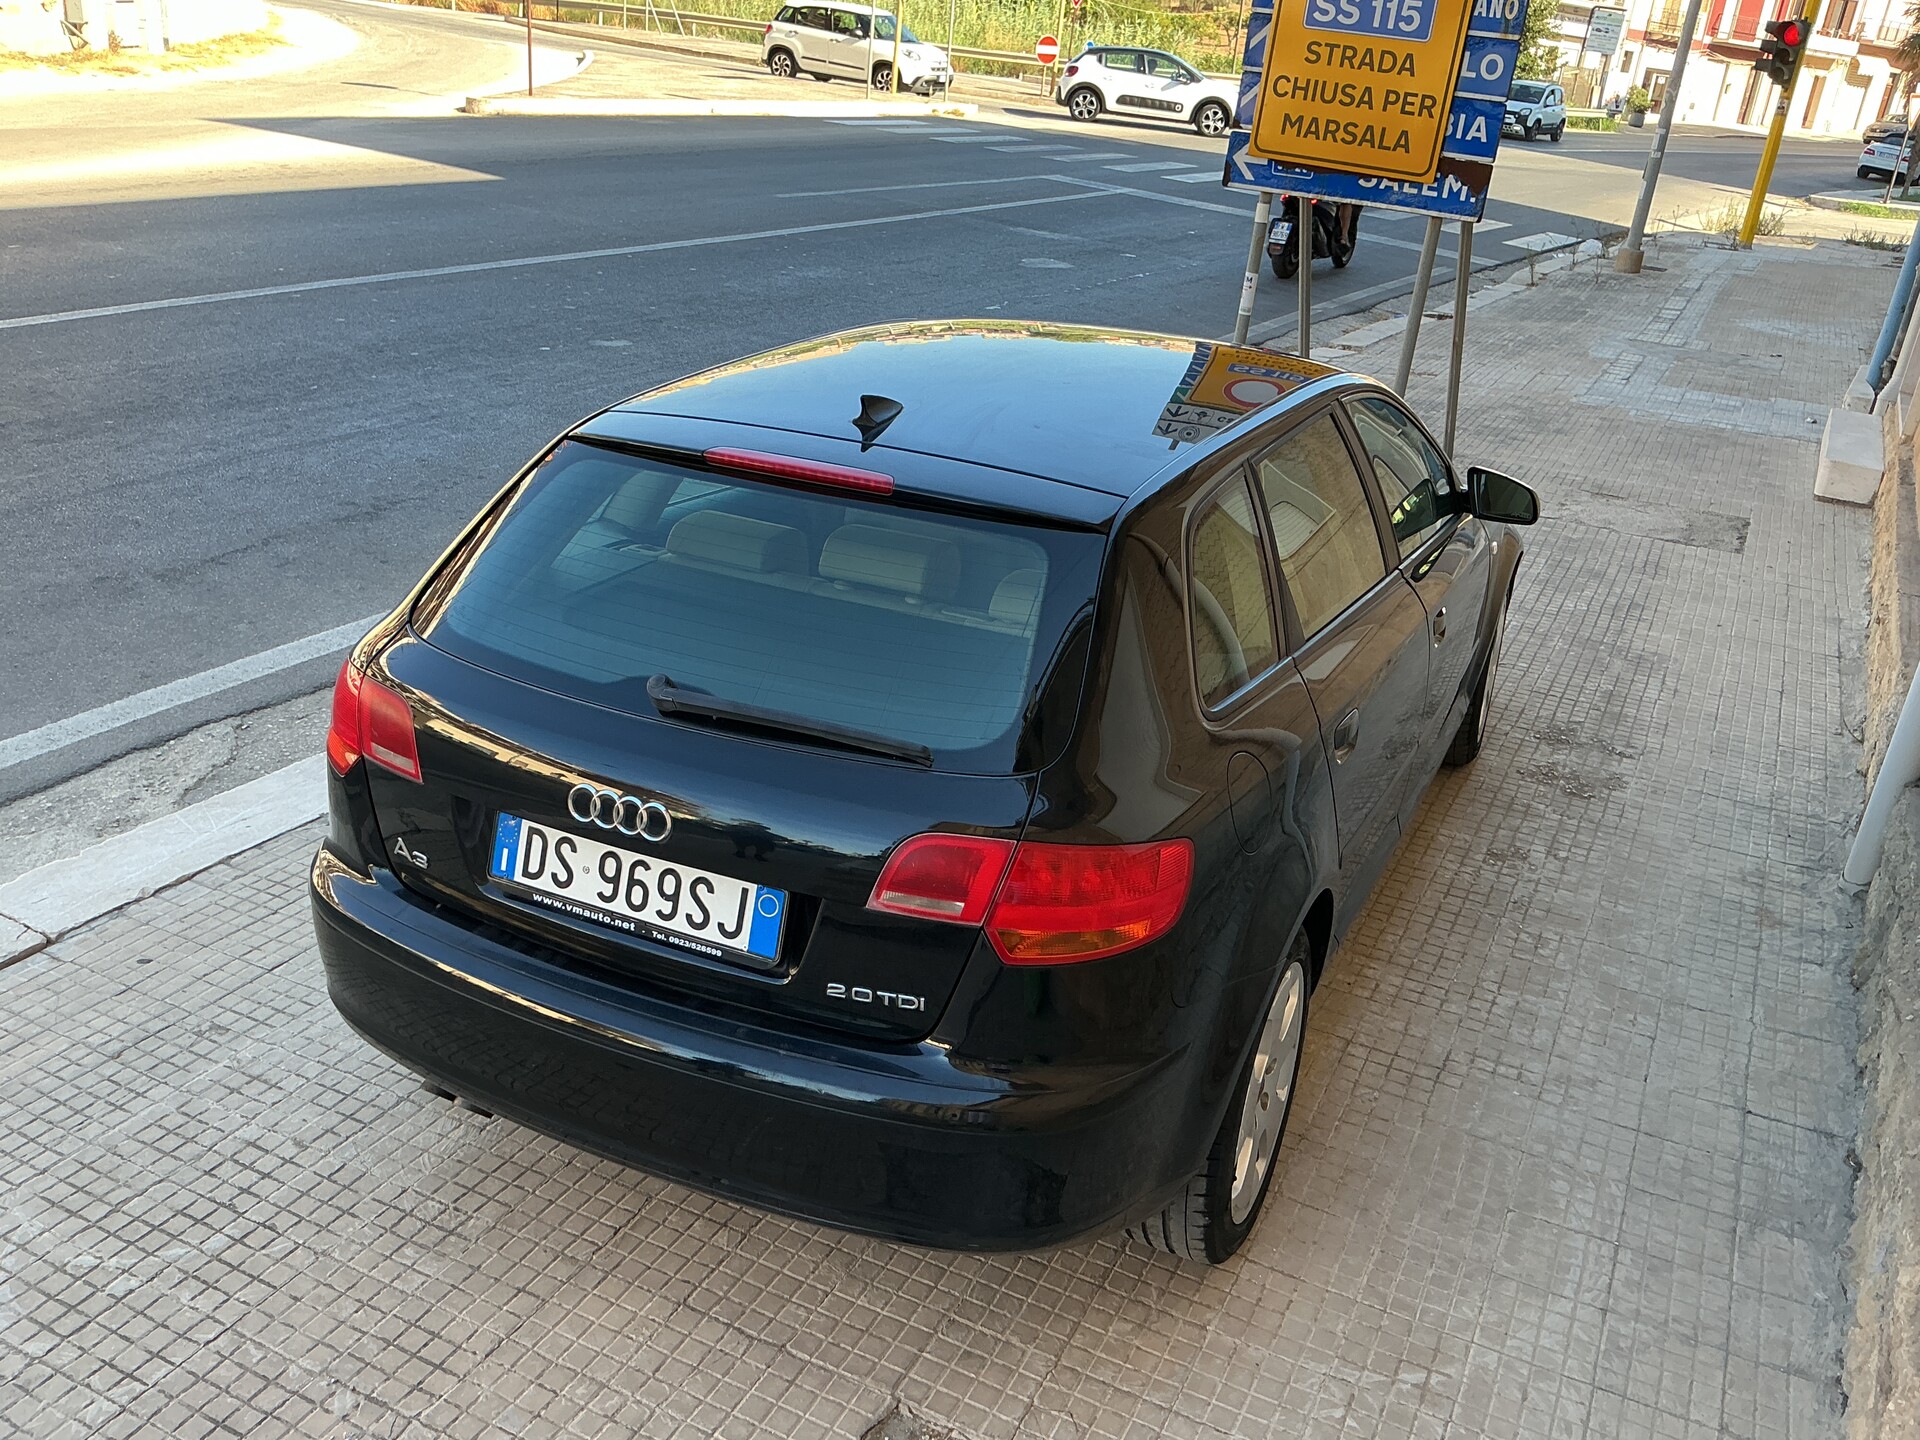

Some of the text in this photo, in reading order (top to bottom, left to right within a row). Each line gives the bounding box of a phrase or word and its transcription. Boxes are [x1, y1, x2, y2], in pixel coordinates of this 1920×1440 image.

[1313, 0, 1421, 31] SS 115
[1304, 41, 1415, 77] STRADA
[1461, 51, 1504, 80] LO
[1273, 75, 1437, 119] CHIUSA PER
[1281, 113, 1410, 153] MARSALA
[394, 837, 428, 869] A3
[522, 826, 577, 889] DS
[597, 850, 749, 939] 969SJ
[533, 893, 636, 932] www.vmauto.net
[652, 931, 667, 942] Tel.
[877, 991, 925, 1012] TDI
